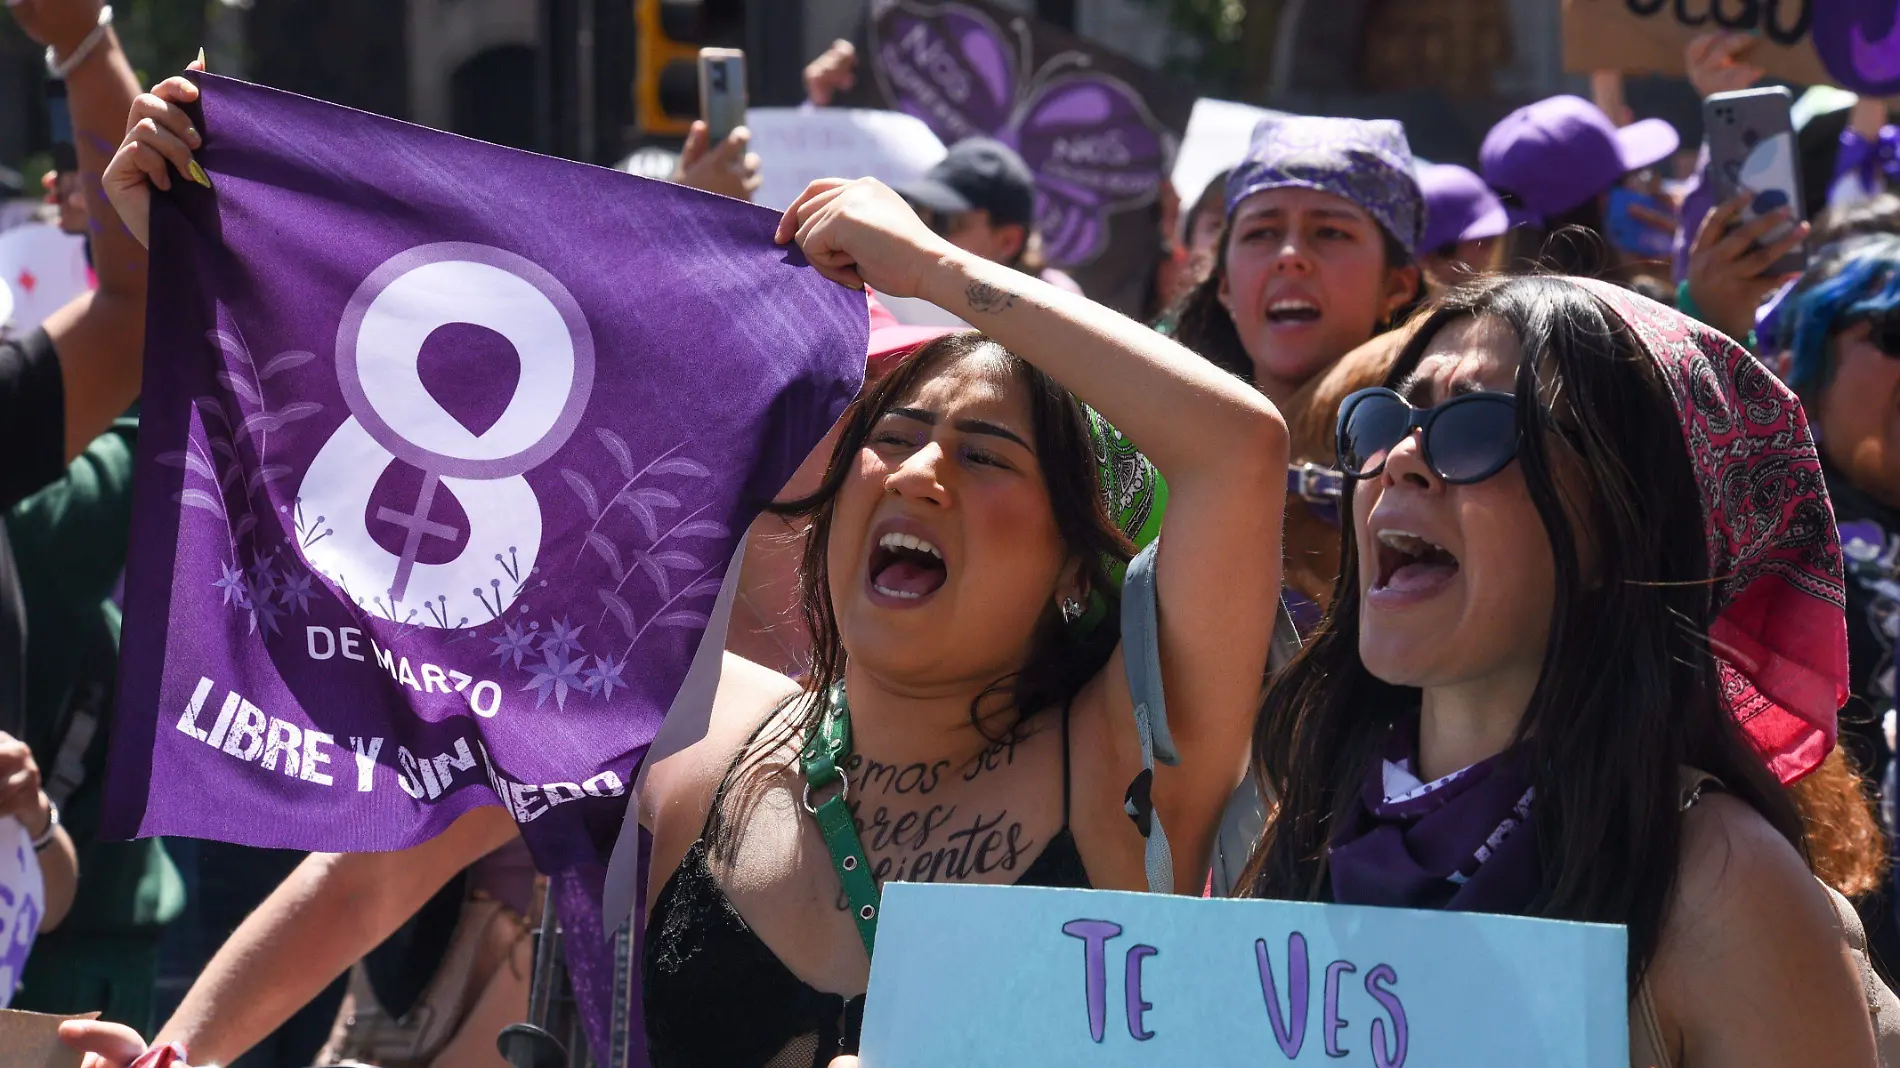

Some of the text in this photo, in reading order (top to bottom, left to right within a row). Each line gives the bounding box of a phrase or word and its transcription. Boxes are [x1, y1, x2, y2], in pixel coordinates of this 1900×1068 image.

[294, 250, 582, 630] 8
[175, 676, 335, 786] LIBRE
[350, 736, 384, 792] Y
[398, 737, 477, 801] SIN
[306, 625, 502, 718] DE MARZO
[1062, 918, 1408, 1068] TE VES
